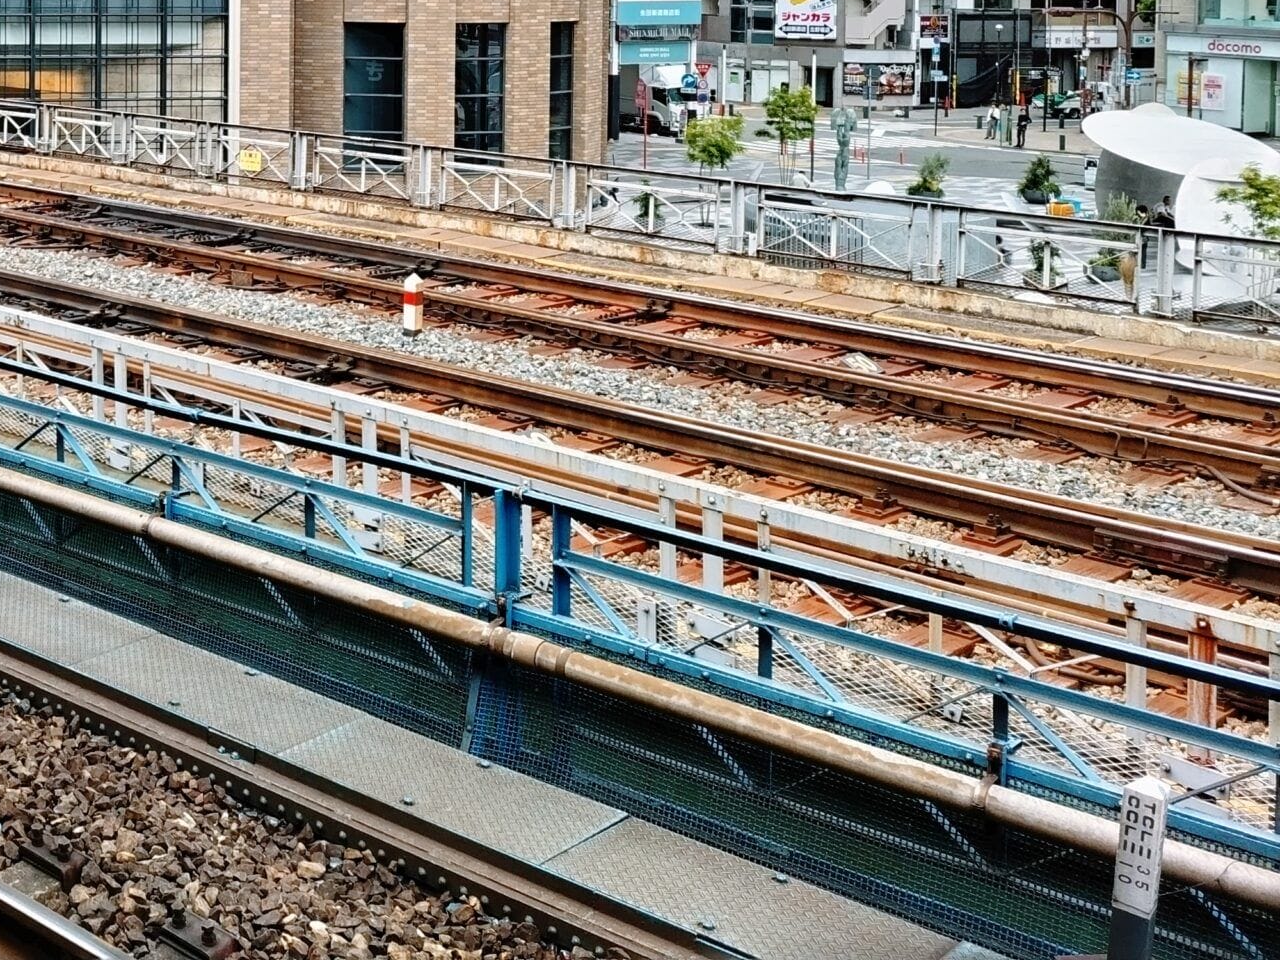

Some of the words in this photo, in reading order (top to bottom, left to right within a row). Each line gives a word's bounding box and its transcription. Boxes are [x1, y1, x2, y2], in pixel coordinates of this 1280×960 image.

[782, 12, 830, 22] ジャンカラ
[1208, 40, 1261, 54] docomo
